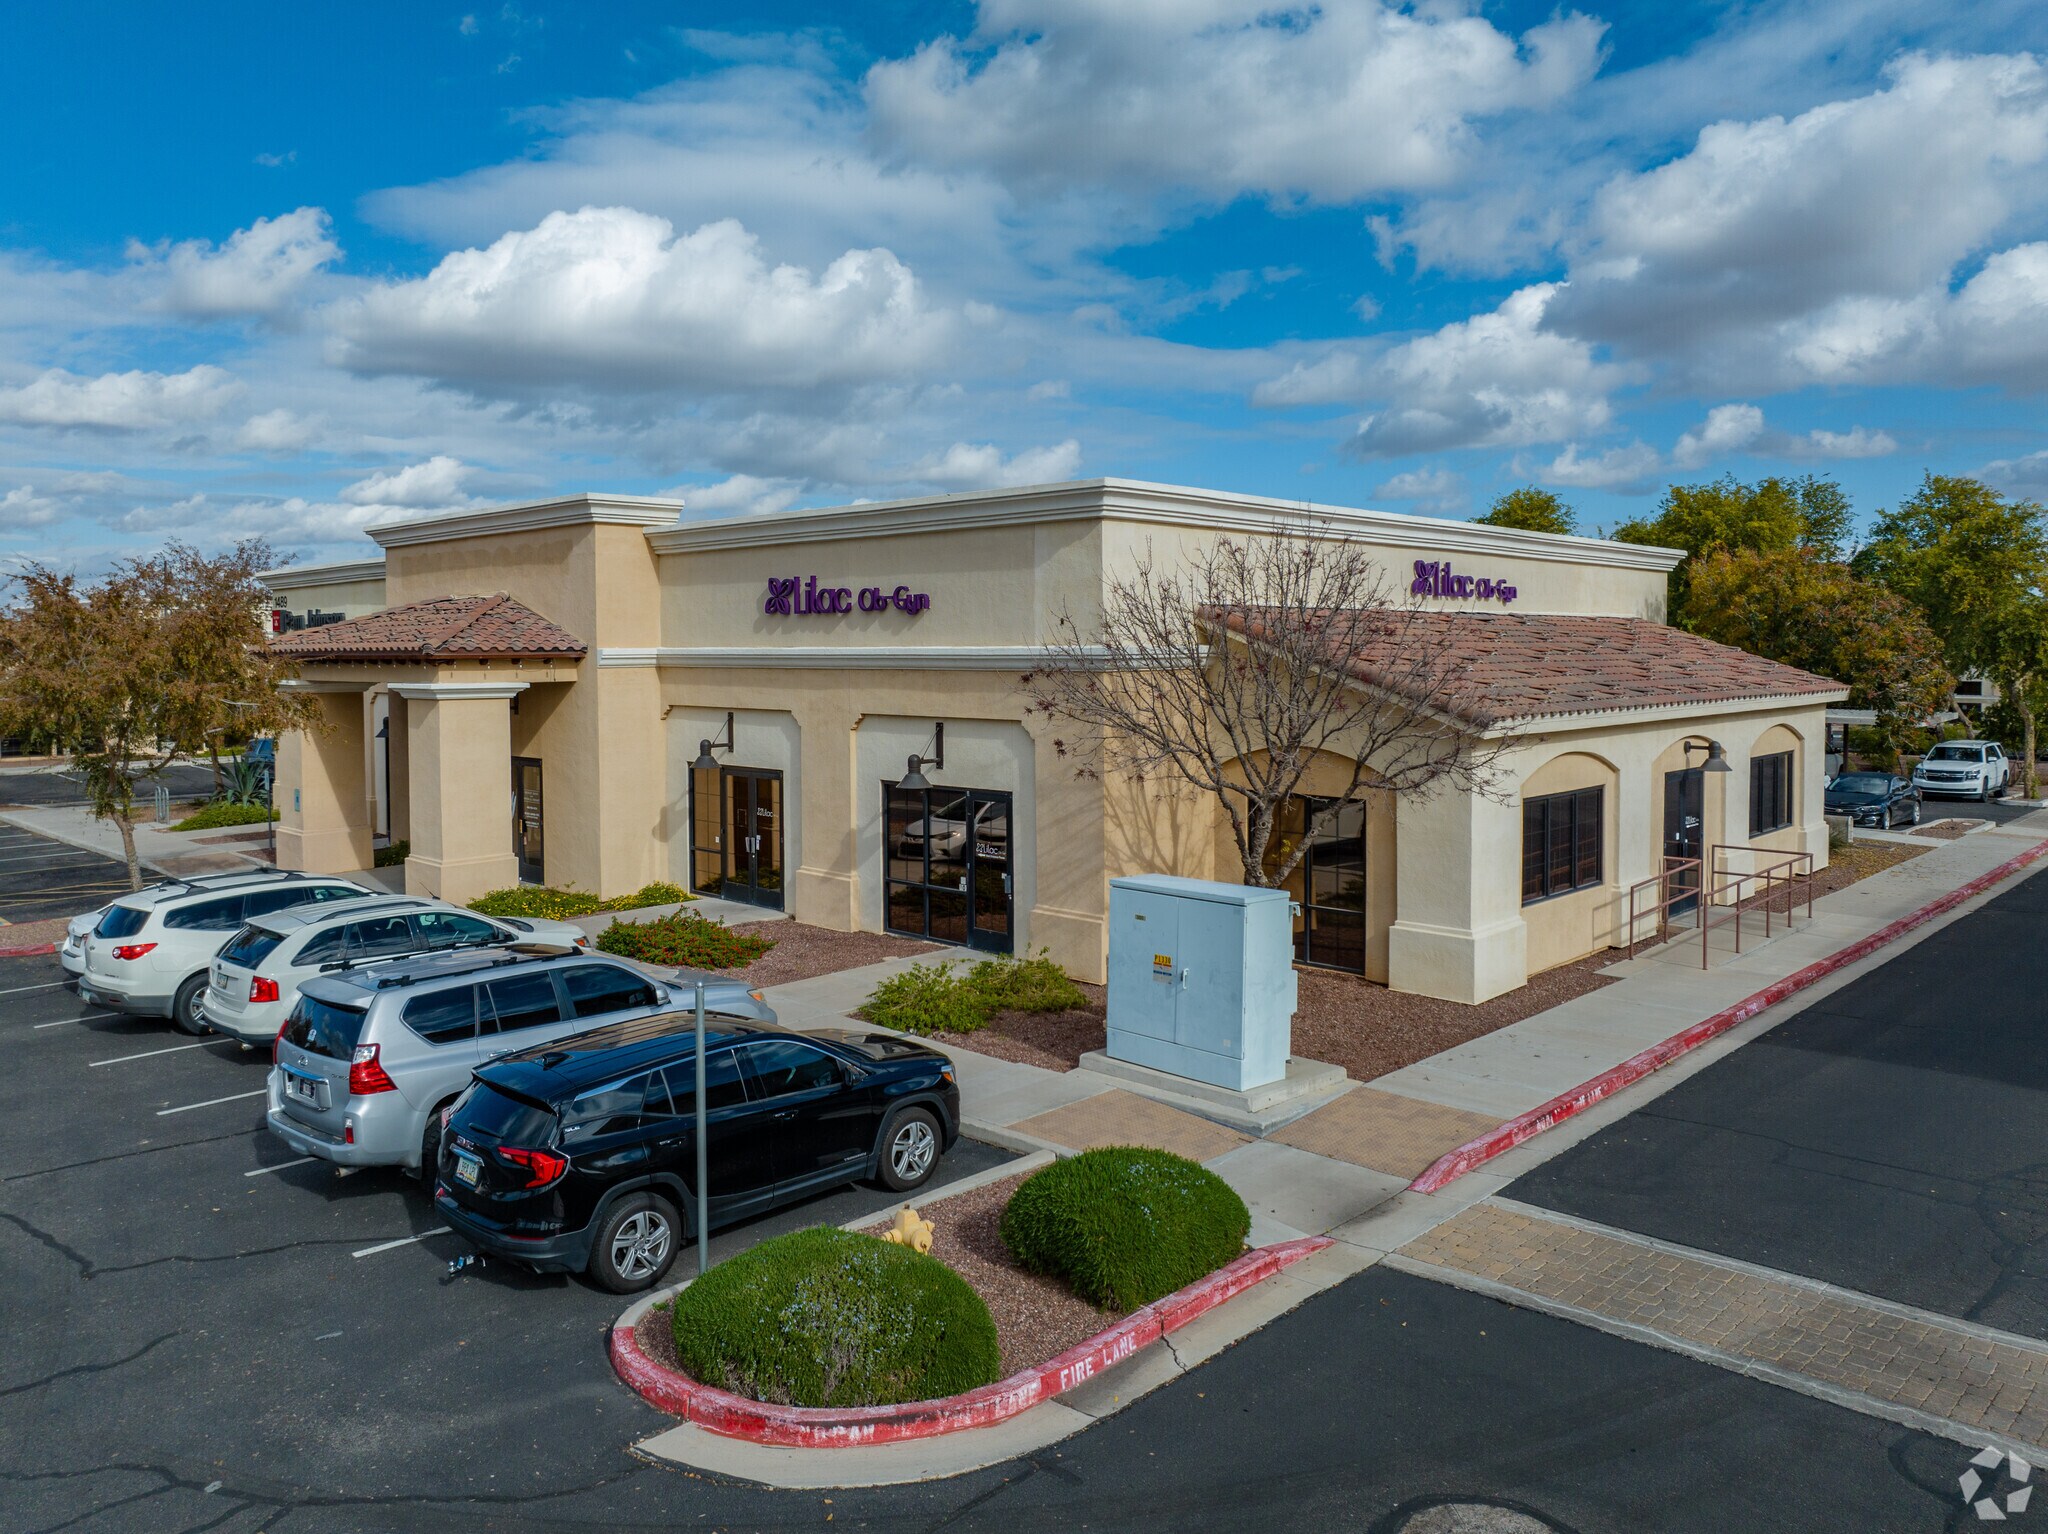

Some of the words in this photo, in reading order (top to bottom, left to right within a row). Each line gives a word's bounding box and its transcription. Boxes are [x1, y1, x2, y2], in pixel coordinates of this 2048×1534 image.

[793, 575, 852, 614] Lilac
[858, 585, 930, 615] Ob-Gyn
[1432, 561, 1475, 597] Lilac
[1475, 578, 1517, 602] Ob-Gyn
[274, 596, 288, 608] 1489
[1060, 1356, 1095, 1390] FIRE
[1102, 1331, 1137, 1365] LANE
